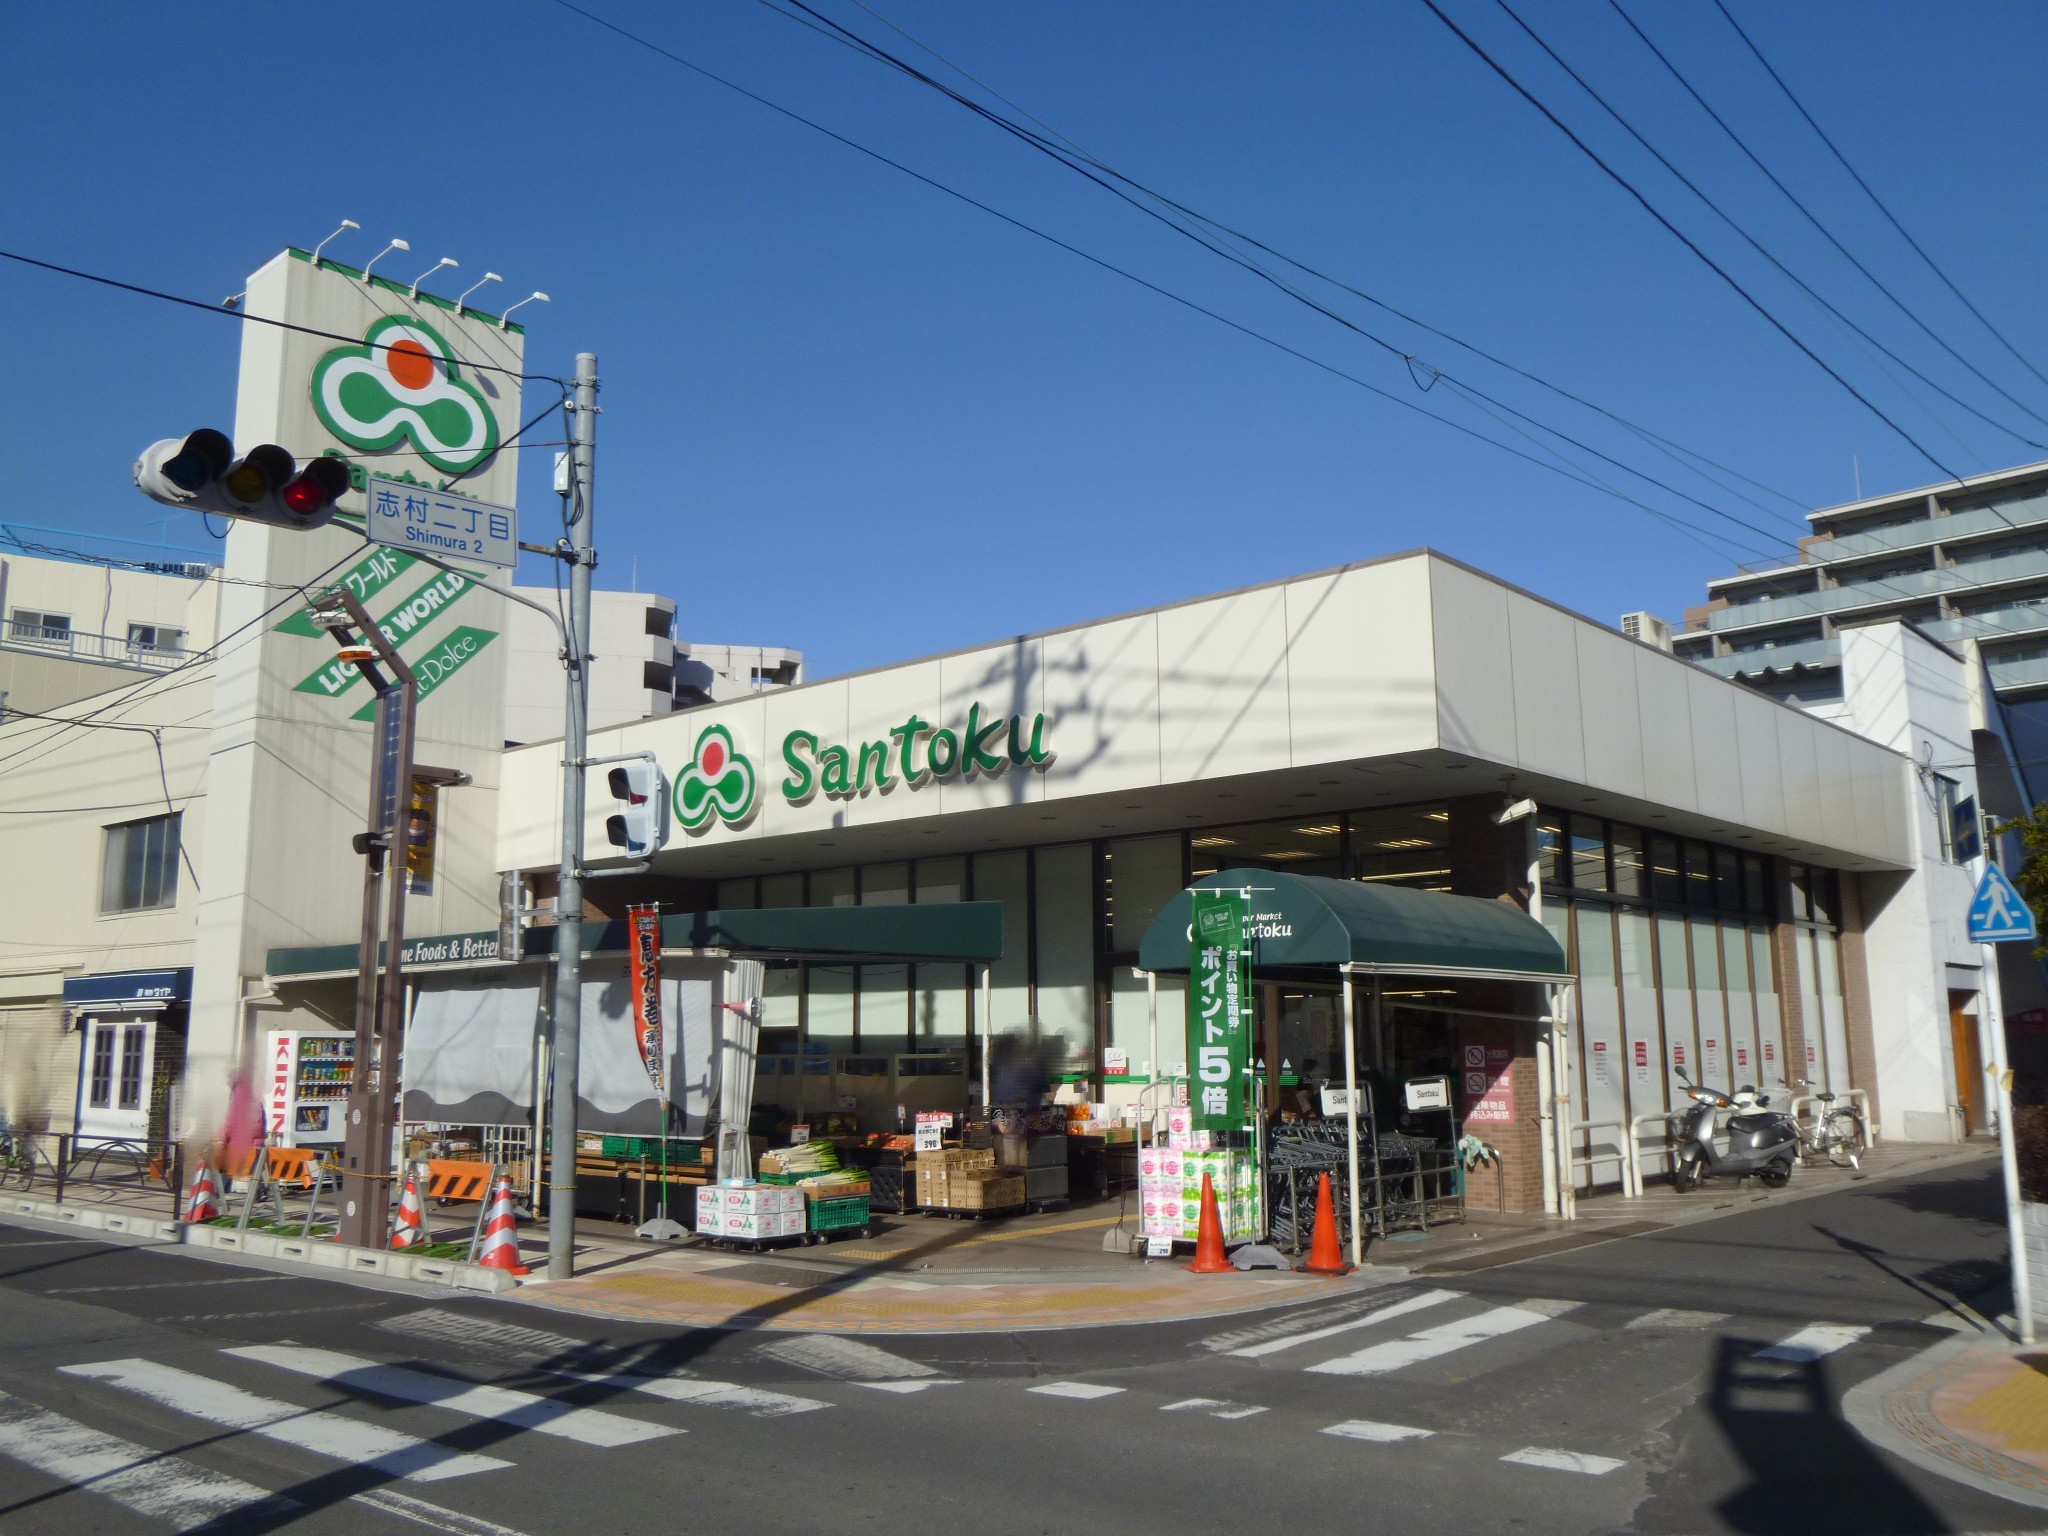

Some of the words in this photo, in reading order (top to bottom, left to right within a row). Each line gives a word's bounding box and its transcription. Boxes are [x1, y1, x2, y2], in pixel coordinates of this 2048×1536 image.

[376, 491, 509, 540] 志村二丁目
[406, 526, 467, 550] Shimura
[474, 540, 483, 554] 2
[391, 571, 465, 632] WORLD
[781, 701, 1051, 801] Santoku
[1256, 911, 1282, 921] Market
[415, 942, 447, 962] Foods
[449, 940, 460, 959] &
[463, 937, 498, 958] Better
[1199, 945, 1231, 1115] ポイント5倍
[272, 1038, 290, 1138] KIRIN
[1417, 1087, 1439, 1099] Santoku
